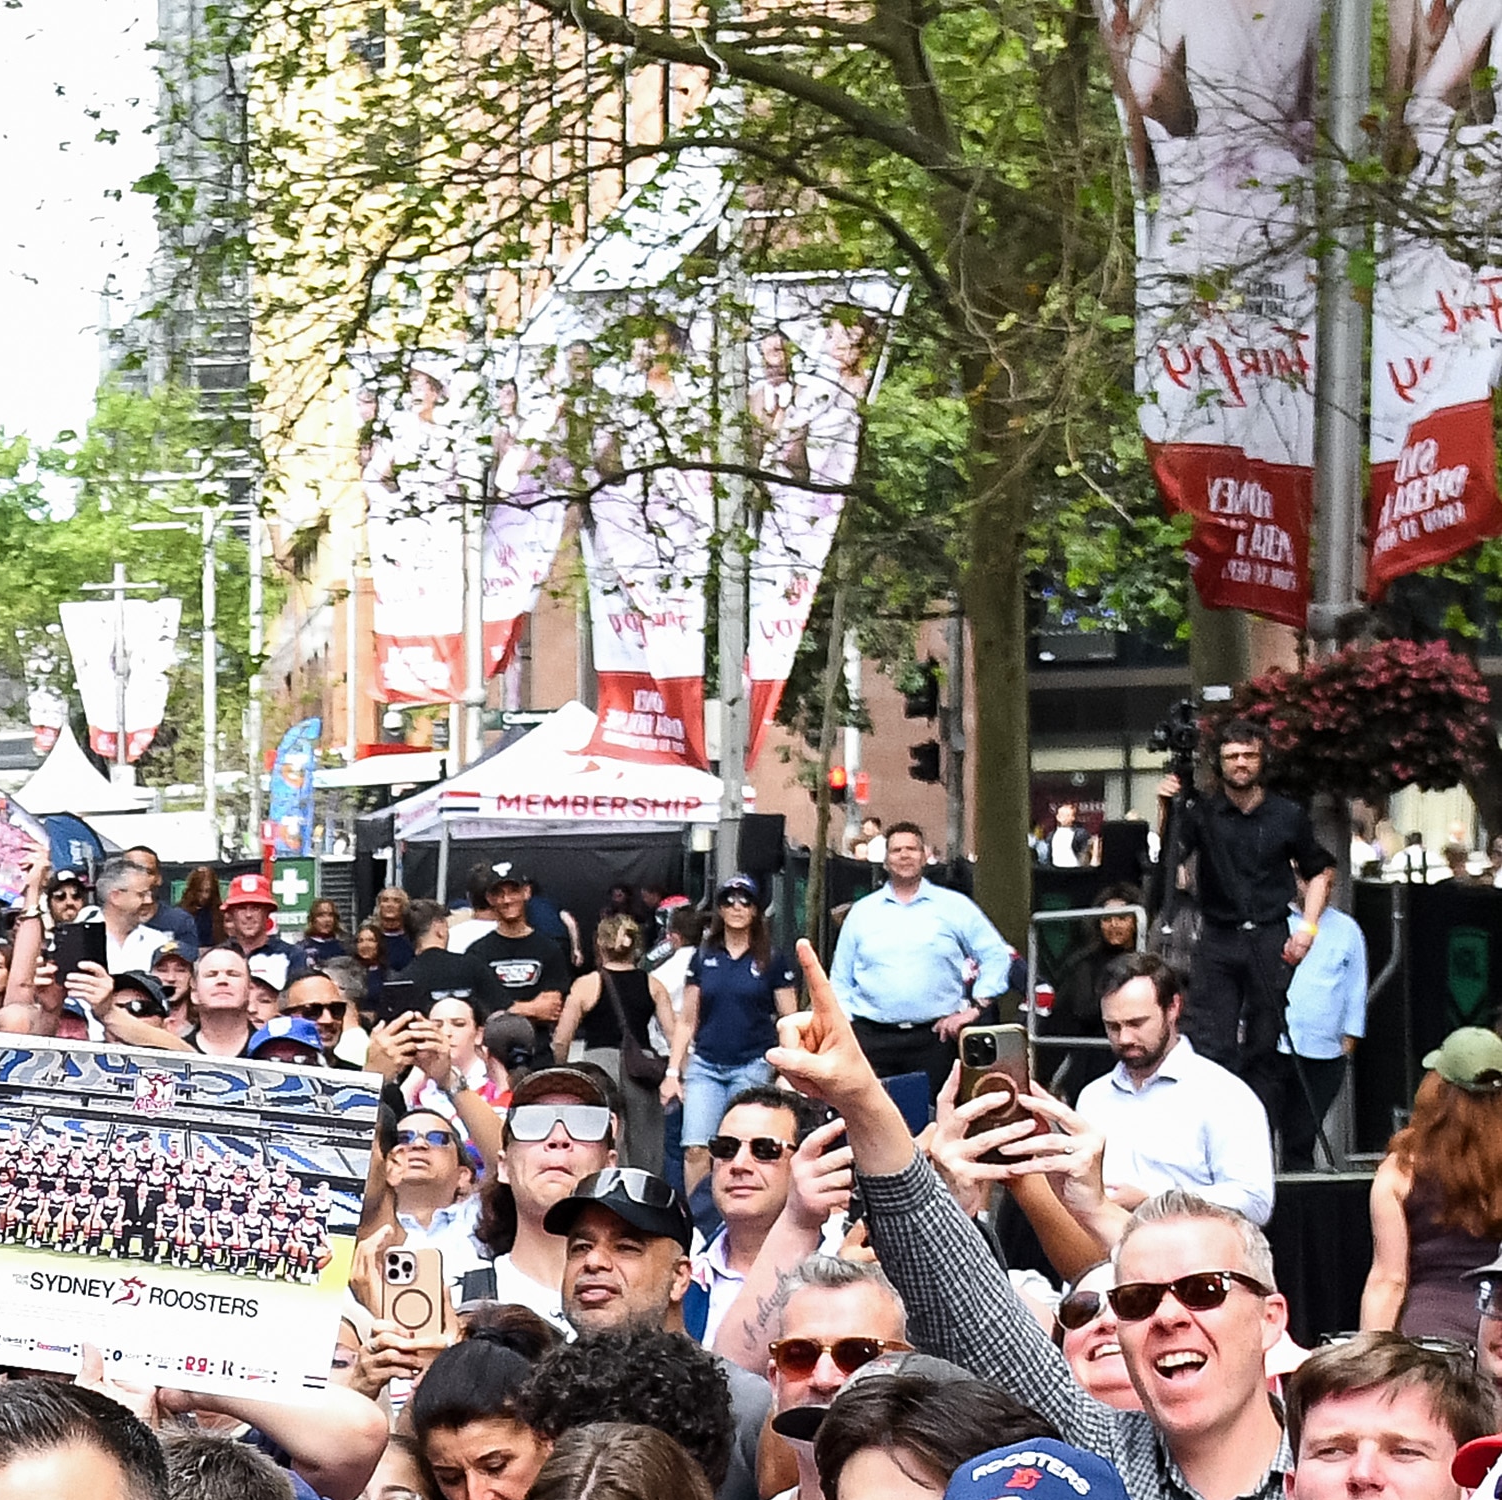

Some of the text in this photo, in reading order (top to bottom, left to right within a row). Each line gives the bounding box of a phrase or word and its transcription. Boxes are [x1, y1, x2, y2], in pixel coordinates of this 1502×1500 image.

[496, 793, 703, 818] MEMBERSHIP
[30, 1271, 116, 1300] SYDNEY
[150, 1287, 259, 1318] ROOSTERS
[972, 1450, 1092, 1496] ROOSTERS
